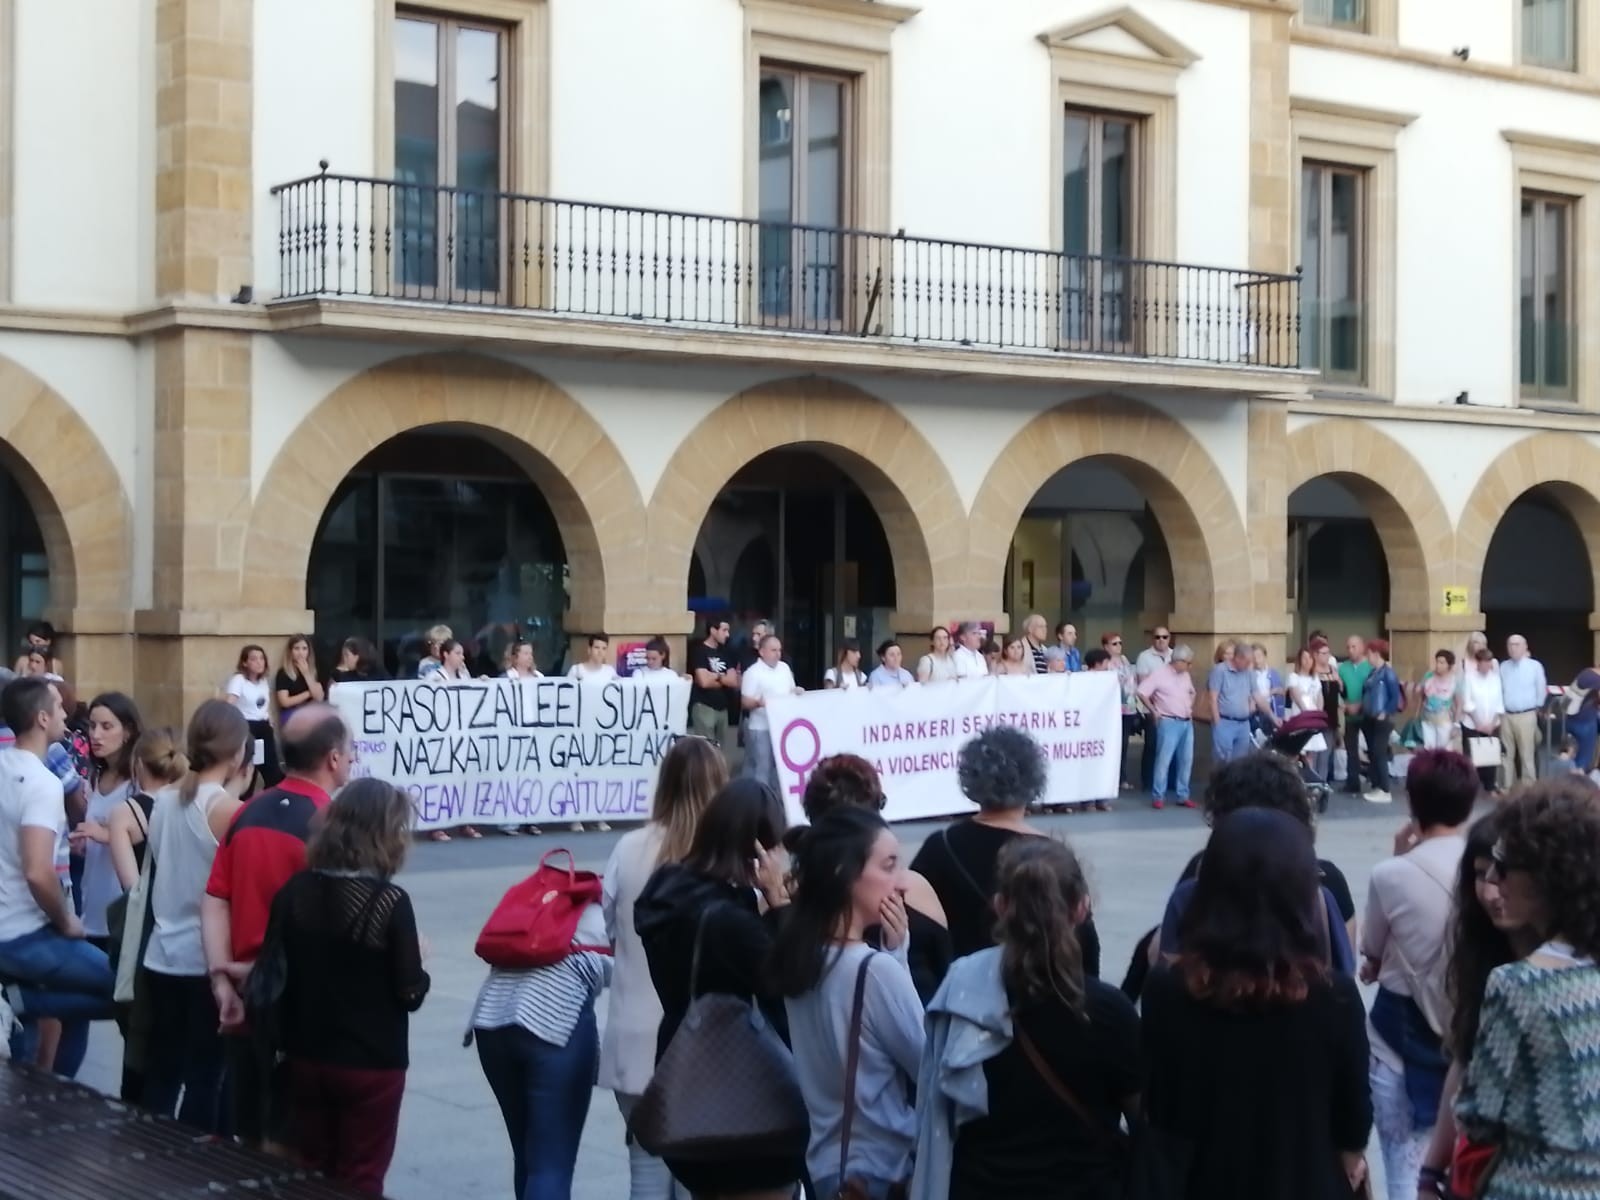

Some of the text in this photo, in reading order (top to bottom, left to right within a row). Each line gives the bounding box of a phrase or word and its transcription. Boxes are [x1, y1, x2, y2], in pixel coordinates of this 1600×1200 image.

[362, 679, 671, 734] ERASOTZAILEEI SUA!
[862, 717, 956, 744] INDARKERI
[1063, 709, 1082, 728] EZ
[392, 735, 541, 776] NAZKATUTA
[1052, 738, 1106, 761] MUJERES
[473, 778, 543, 817] IZANGO
[548, 771, 649, 818] GAITUZUE
